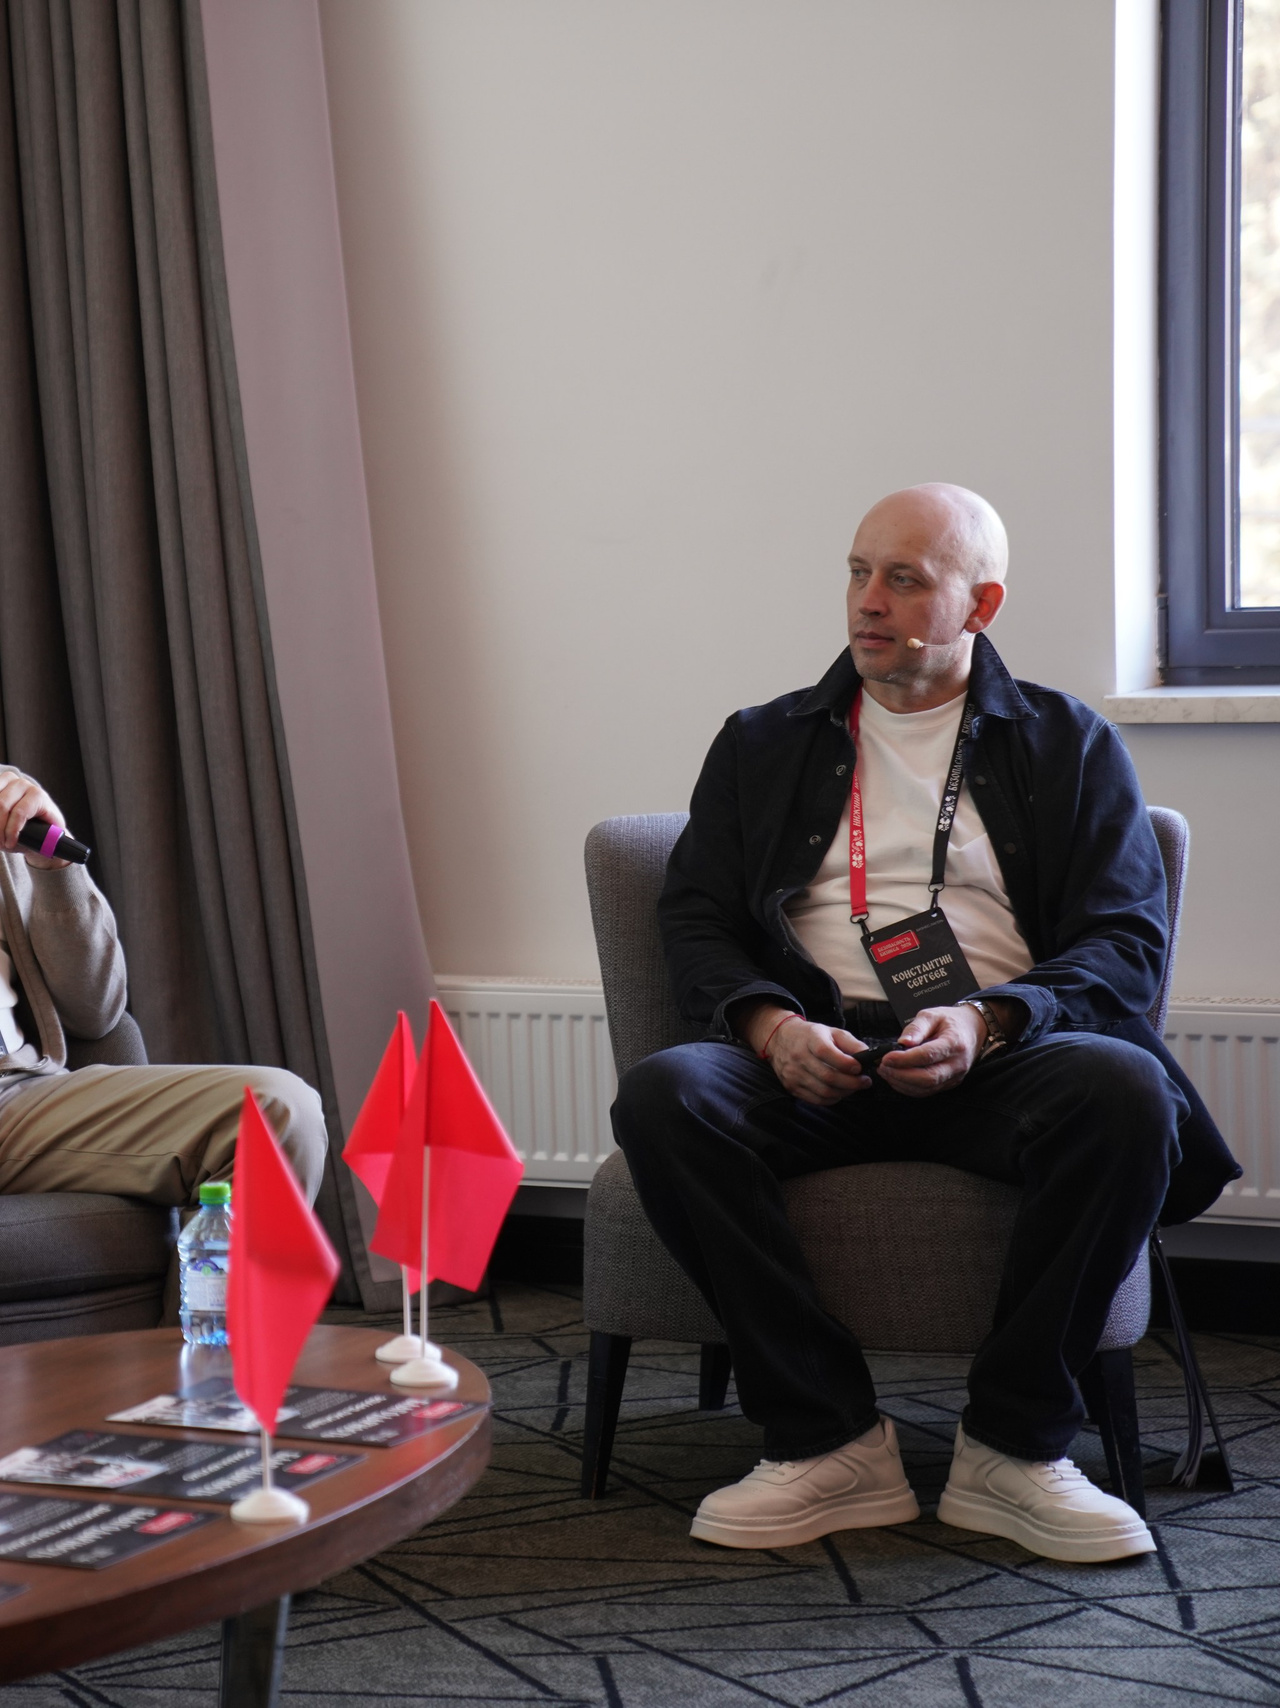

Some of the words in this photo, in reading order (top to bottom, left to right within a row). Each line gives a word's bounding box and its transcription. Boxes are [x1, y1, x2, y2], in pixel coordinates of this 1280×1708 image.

[891, 953, 954, 984] КОНСТАНТИН
[906, 967, 948, 989] СЕРГЕЕВ
[913, 979, 951, 998] ОРГКОМИТЕТ
